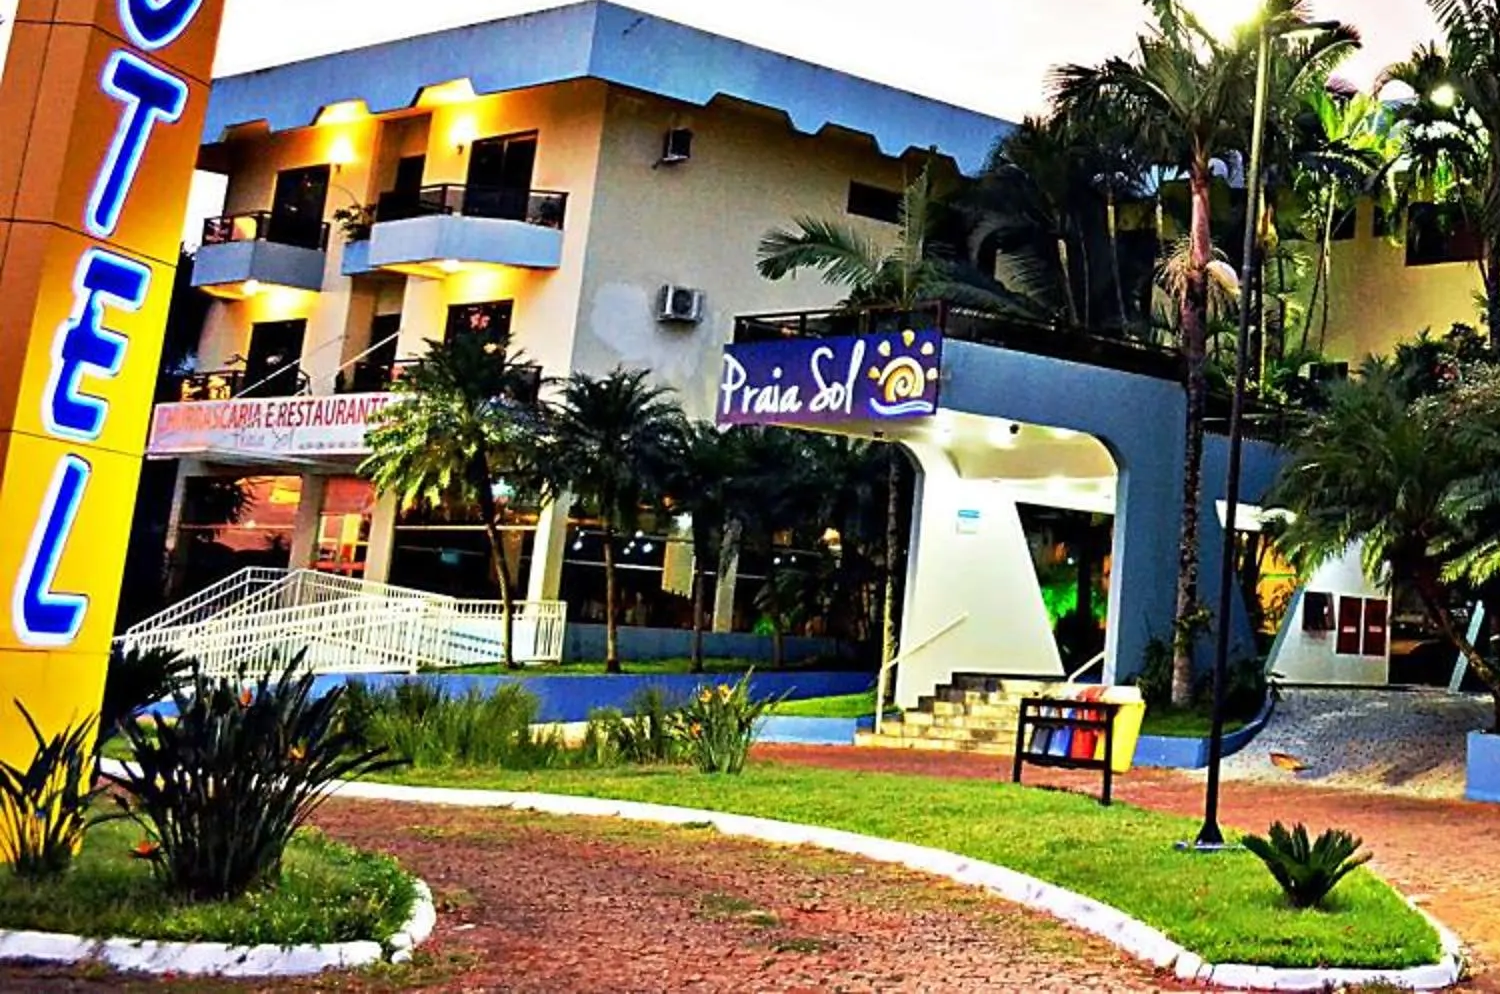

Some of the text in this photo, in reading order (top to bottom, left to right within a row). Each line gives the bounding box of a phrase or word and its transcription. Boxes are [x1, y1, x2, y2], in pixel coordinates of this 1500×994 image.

[721, 339, 865, 414] Praia Sol
[265, 402, 275, 428] E
